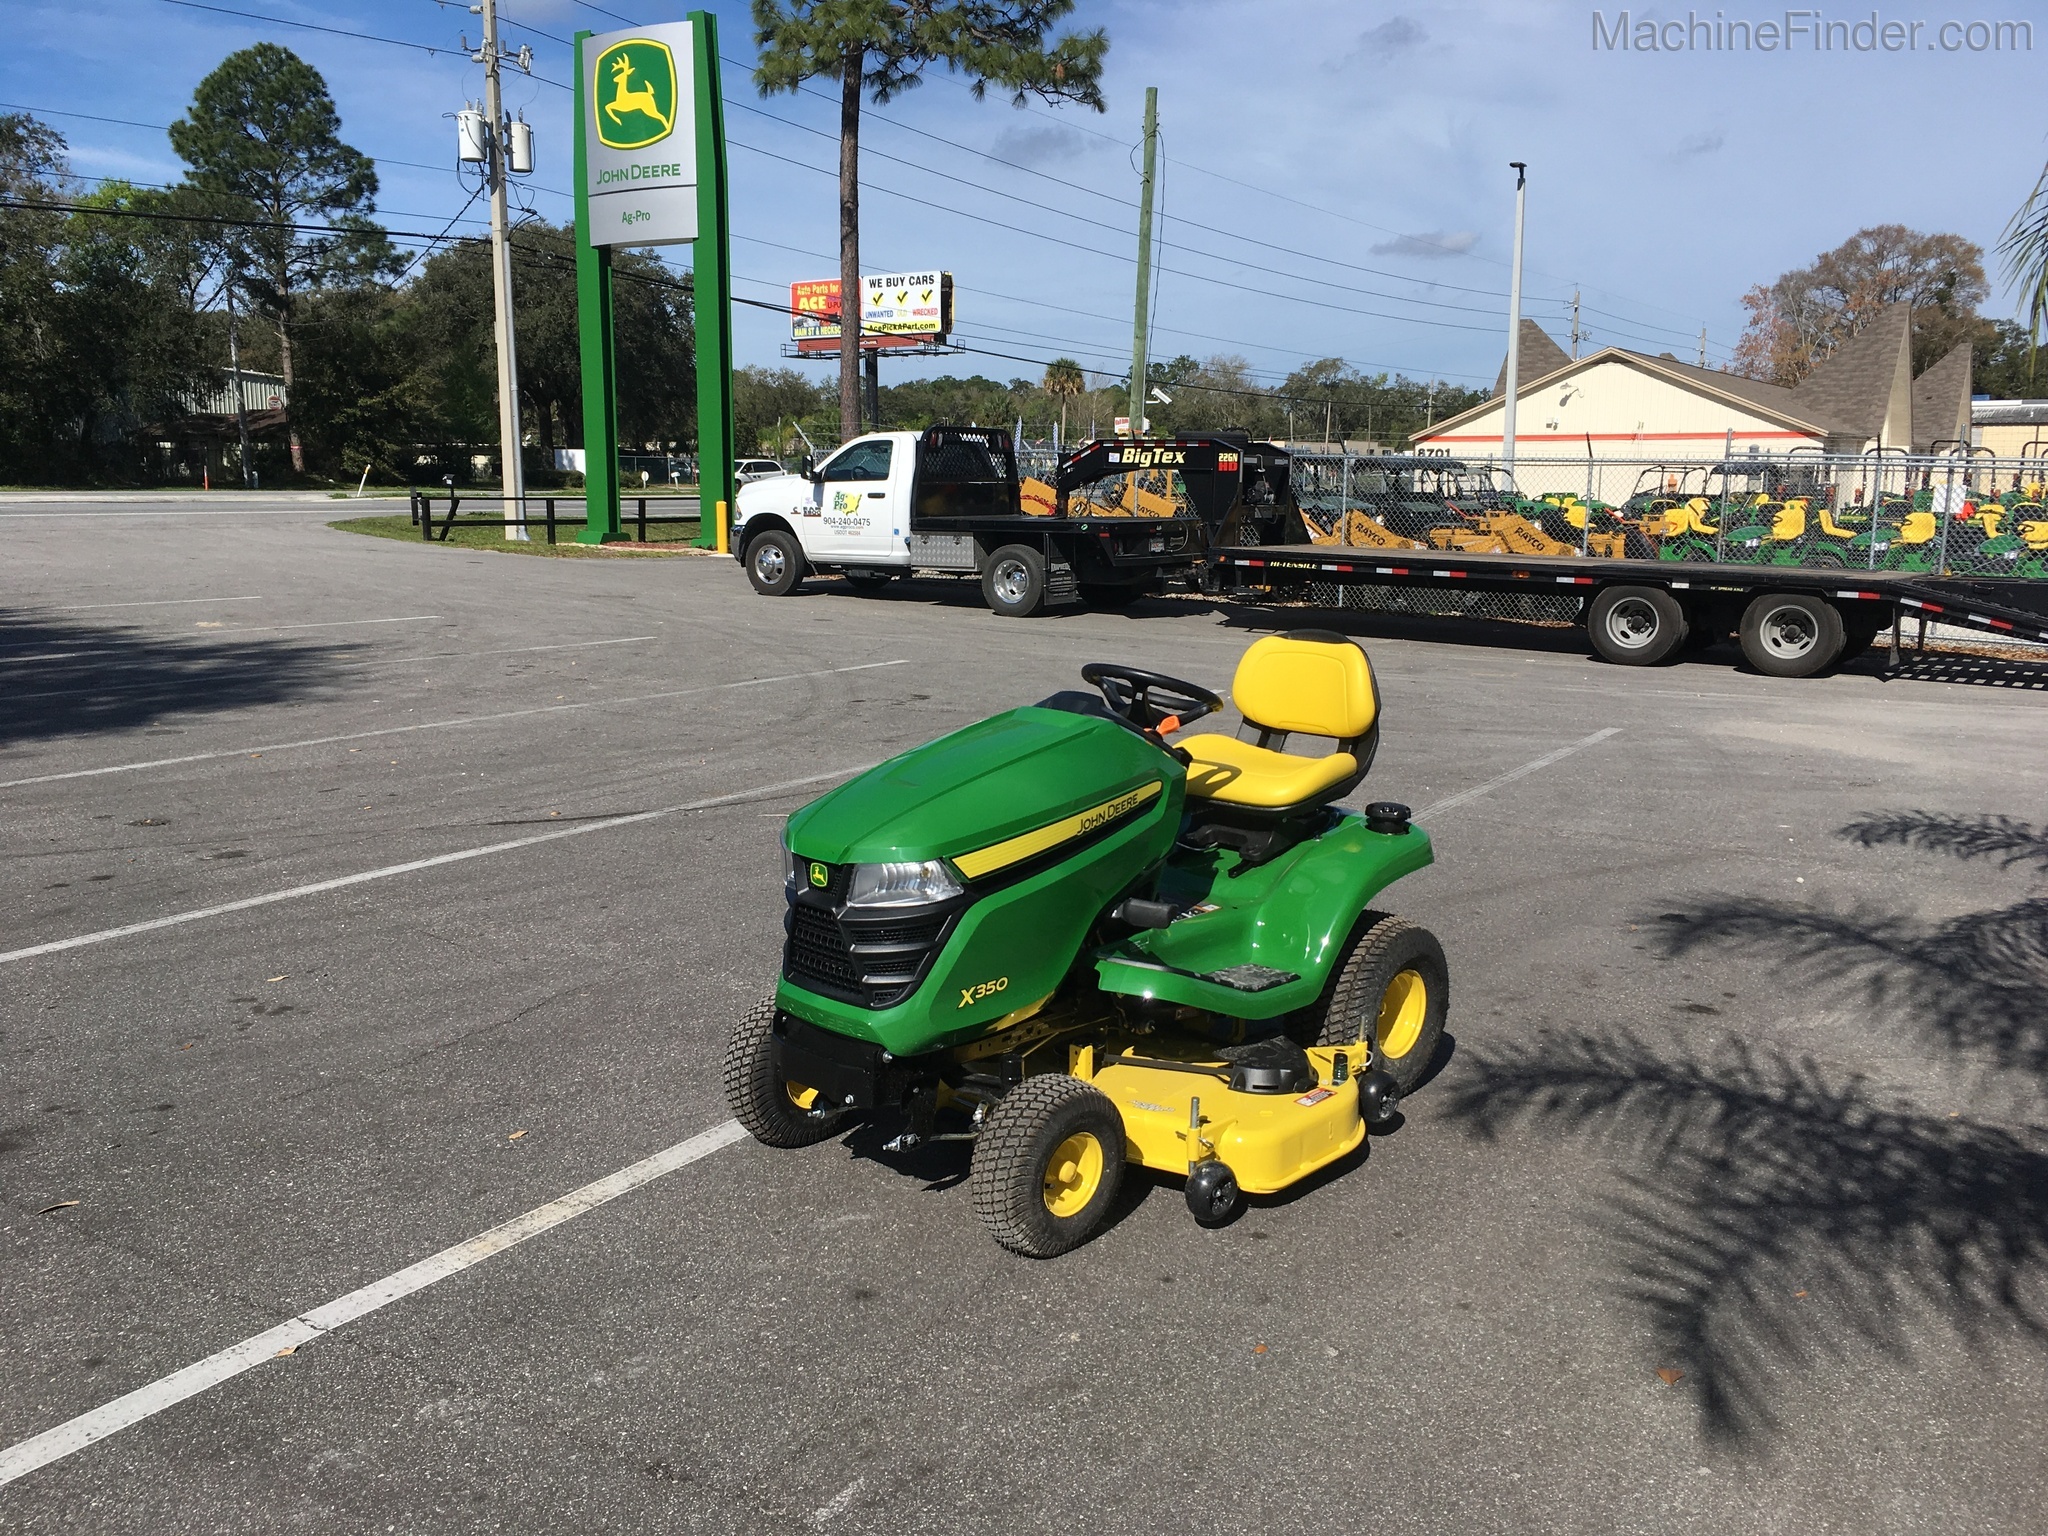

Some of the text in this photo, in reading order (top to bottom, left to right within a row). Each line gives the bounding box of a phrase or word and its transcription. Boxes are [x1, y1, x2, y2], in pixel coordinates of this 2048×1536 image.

[596, 163, 681, 185] JOHN DEERE
[621, 209, 651, 225] Ag-Pro
[869, 275, 935, 288] WE BUY CARS
[797, 282, 839, 295] Auto Parts for
[798, 296, 827, 310] ACE
[865, 310, 894, 319] UNWANTED
[912, 307, 938, 316] WRECKED
[794, 328, 807, 337] MAIN
[808, 327, 815, 336] ST
[820, 325, 842, 335] HECKSC
[1121, 448, 1187, 467] BigTex
[1418, 448, 1451, 457] 8701
[1218, 462, 1238, 471] HD
[833, 501, 848, 510] Pro
[823, 517, 871, 527] 904-240-0475
[1355, 522, 1386, 546] RAYCO
[1514, 526, 1546, 552] RAYCO
[1077, 793, 1139, 836] JOHN DEERE
[957, 976, 1009, 1010] X350
